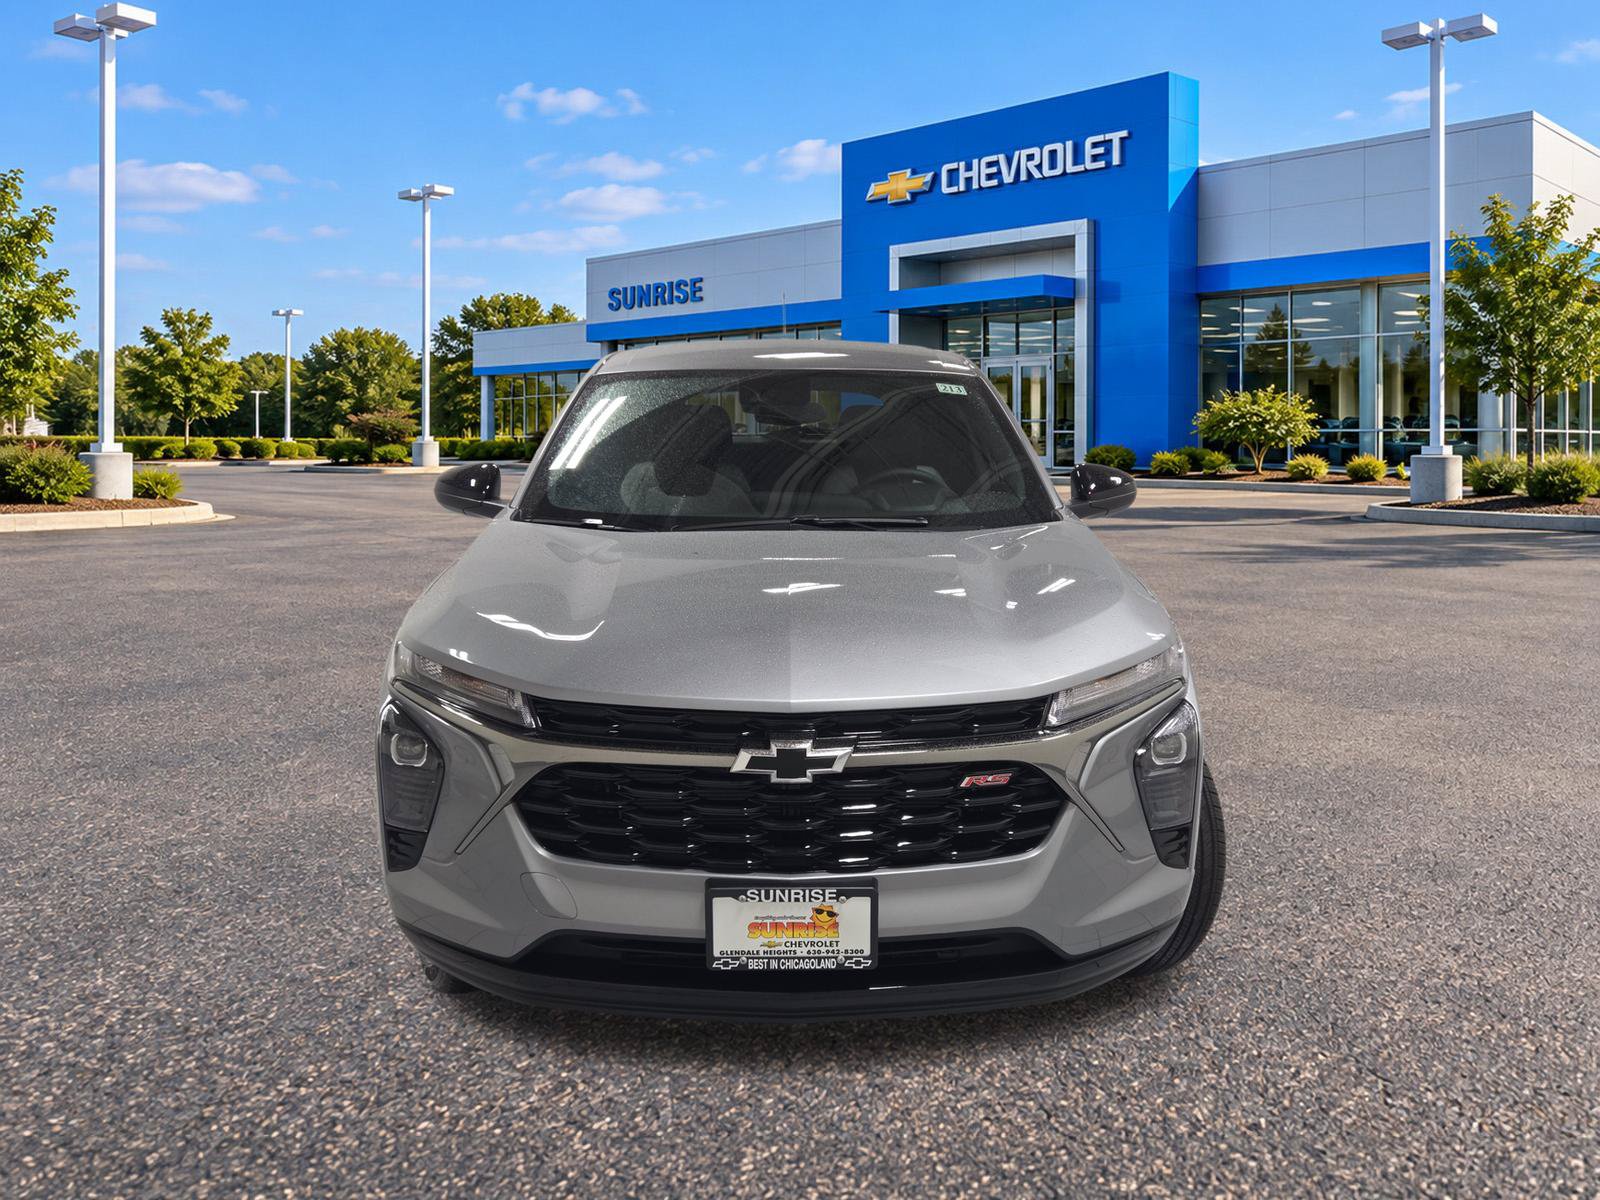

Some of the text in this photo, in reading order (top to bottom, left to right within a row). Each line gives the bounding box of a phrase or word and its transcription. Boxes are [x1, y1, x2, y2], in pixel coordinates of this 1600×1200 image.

[941, 130, 1129, 194] CHEVROLET
[607, 277, 704, 312] SUNRISE
[960, 773, 1012, 787] RS
[746, 889, 837, 903] SUNRISE
[747, 921, 839, 938] SUNRISE
[784, 940, 840, 948] CHEVROLET
[748, 958, 836, 969] BEST IN CHICAGOLAND
